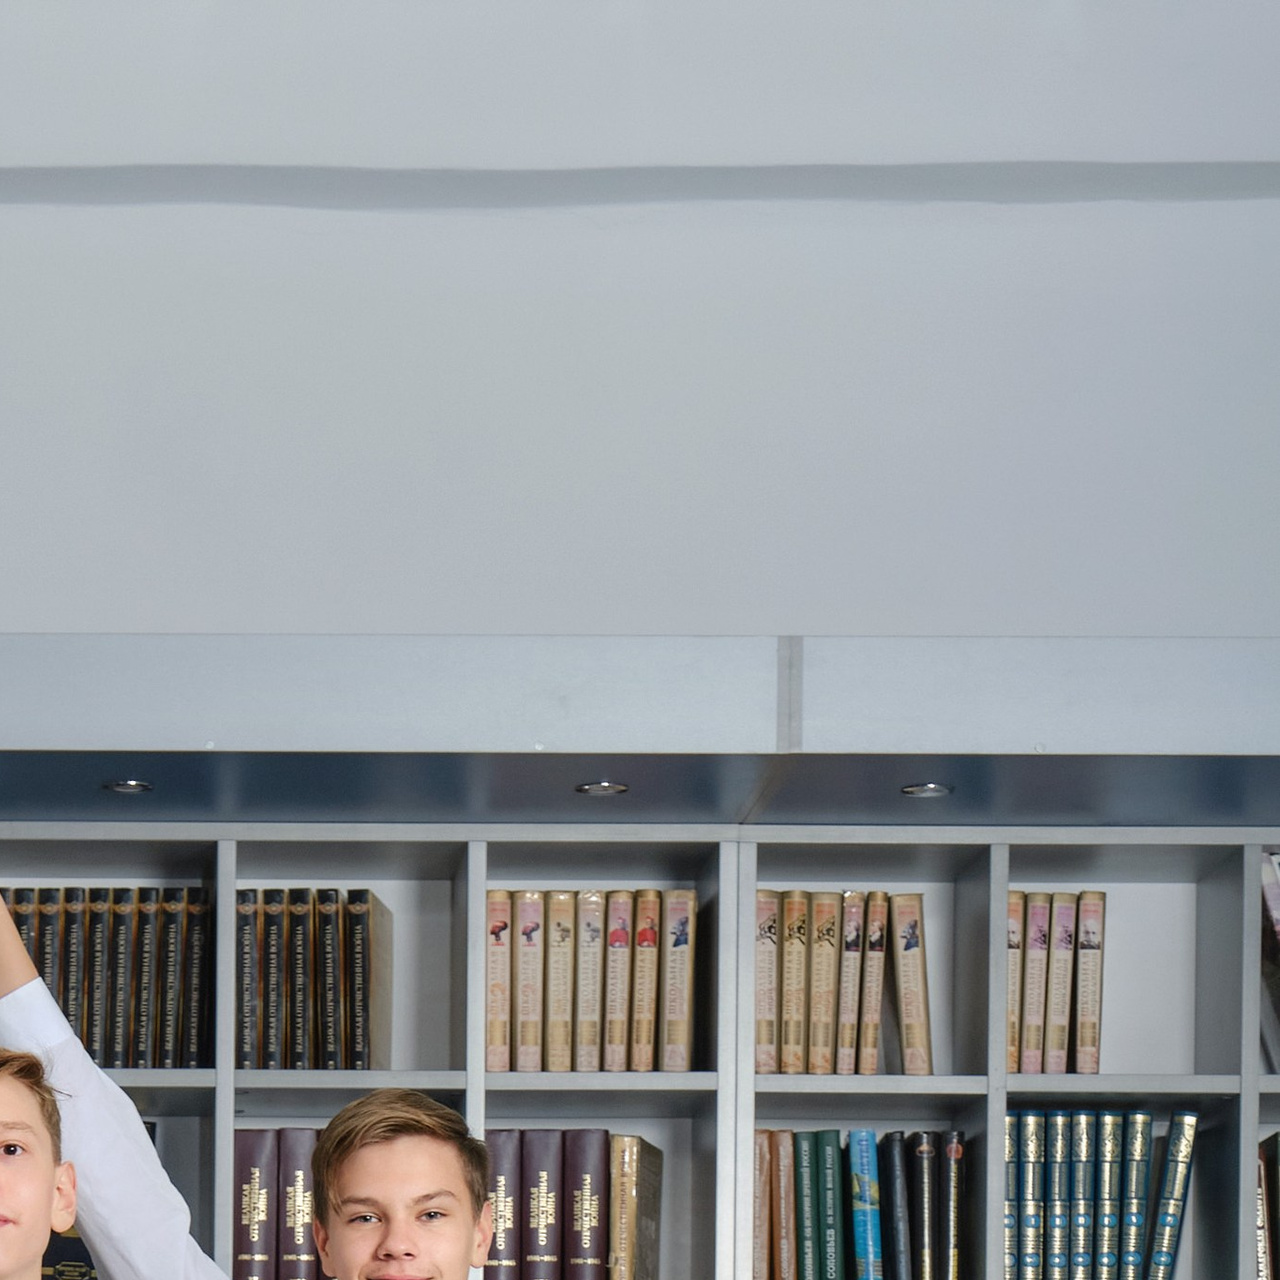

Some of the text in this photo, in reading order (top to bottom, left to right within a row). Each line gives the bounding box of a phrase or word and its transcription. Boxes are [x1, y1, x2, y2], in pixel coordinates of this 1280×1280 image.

[250, 1167, 260, 1242] ОТЕЧЕСТВЕННАЯ
[294, 1170, 304, 1245] ОТЕЧЕСТВЕННАЯ
[497, 1175, 506, 1250] ОТЕЧЕСТВЕННАЯ
[539, 1170, 549, 1246] ОТЕЧЕСТВЕННАЯ
[582, 1174, 592, 1248] ОТЕЧЕСТВЕННАЯ
